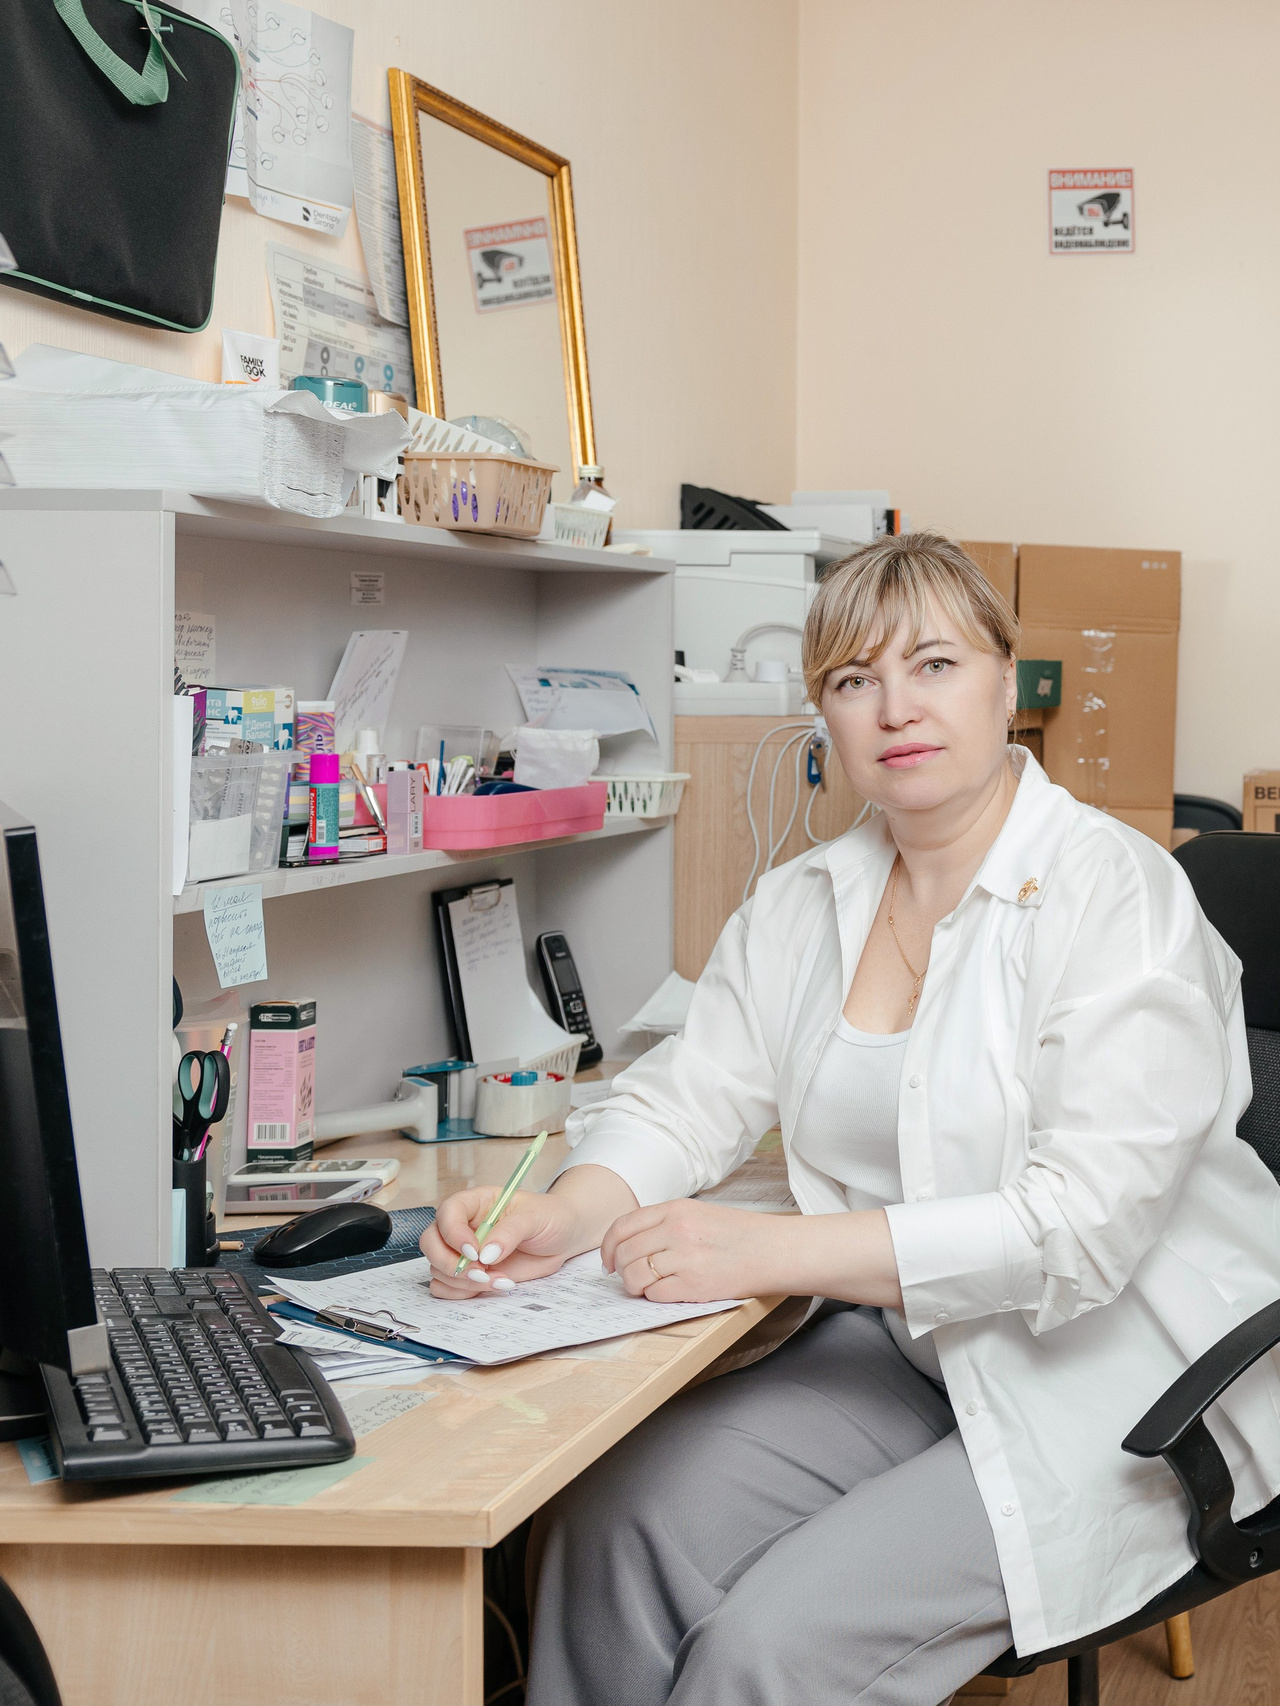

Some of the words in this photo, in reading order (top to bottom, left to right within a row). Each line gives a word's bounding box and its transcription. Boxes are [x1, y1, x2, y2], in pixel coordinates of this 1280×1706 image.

[1051, 171, 1131, 187] ВНИМАНИЕ
[313, 208, 341, 224] Dentsply
[240, 354, 264, 368] FAMILY
[241, 364, 267, 378] LOOK
[249, 719, 272, 731] Дента
[245, 729, 272, 741] Баланс
